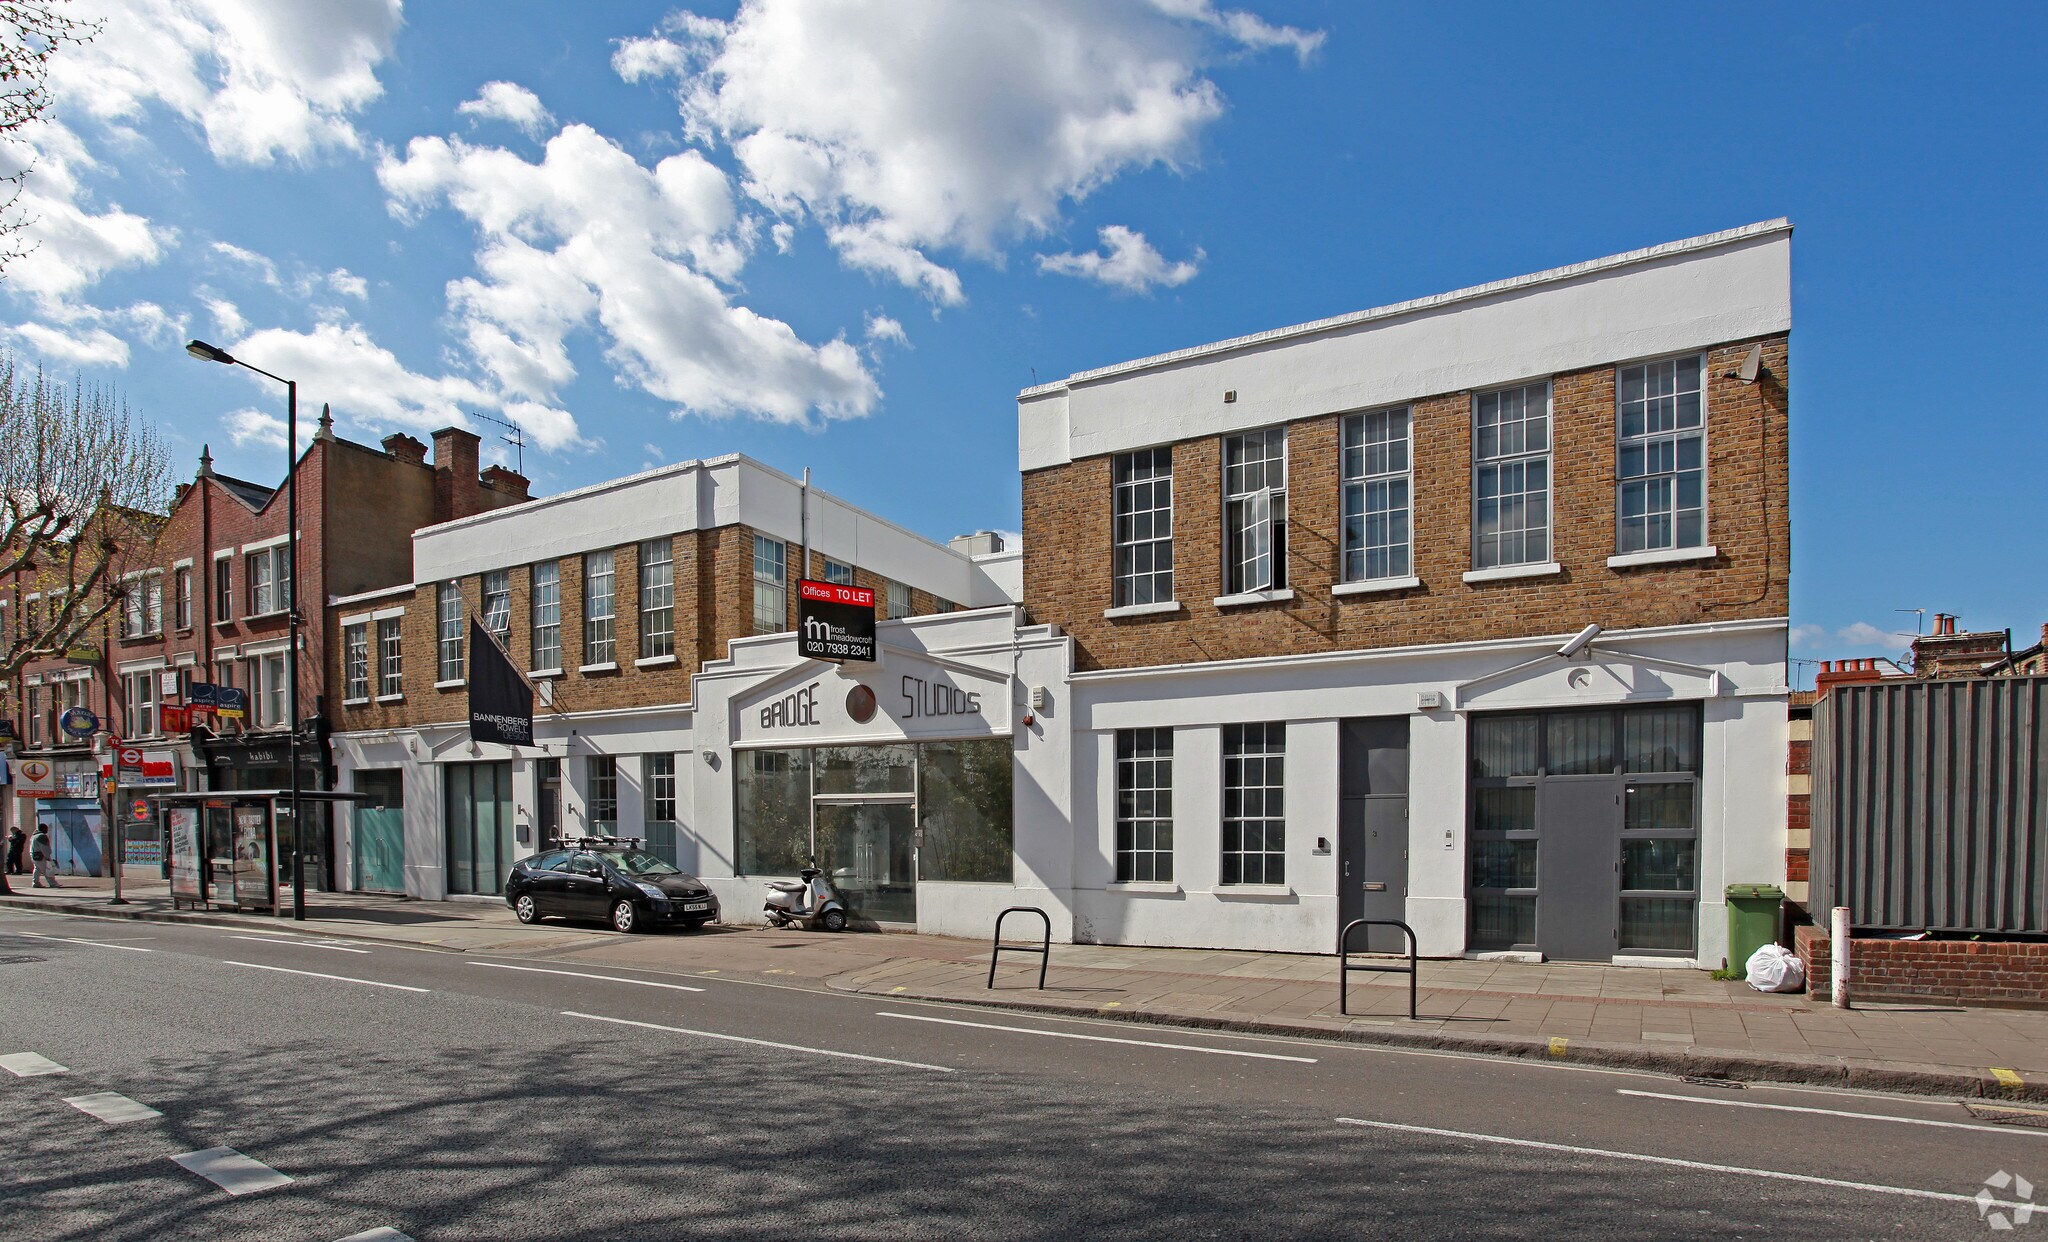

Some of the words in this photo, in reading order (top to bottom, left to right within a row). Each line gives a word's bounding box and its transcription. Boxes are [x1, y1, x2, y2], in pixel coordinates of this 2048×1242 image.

[802, 585, 831, 598] Offices
[836, 588, 850, 600] TO
[852, 591, 871, 603] LET
[830, 624, 846, 634] frost
[830, 634, 873, 645] meadowcroft
[806, 641, 824, 653] 020
[826, 642, 849, 655] 7938
[850, 645, 871, 656] 2341
[902, 675, 982, 719] STUDIOS
[760, 681, 821, 728] BRIDGE
[473, 712, 529, 726] BANNENBERG
[496, 722, 529, 734] ROWELL
[502, 731, 530, 741] DESIGN
[249, 751, 274, 761] habibi
